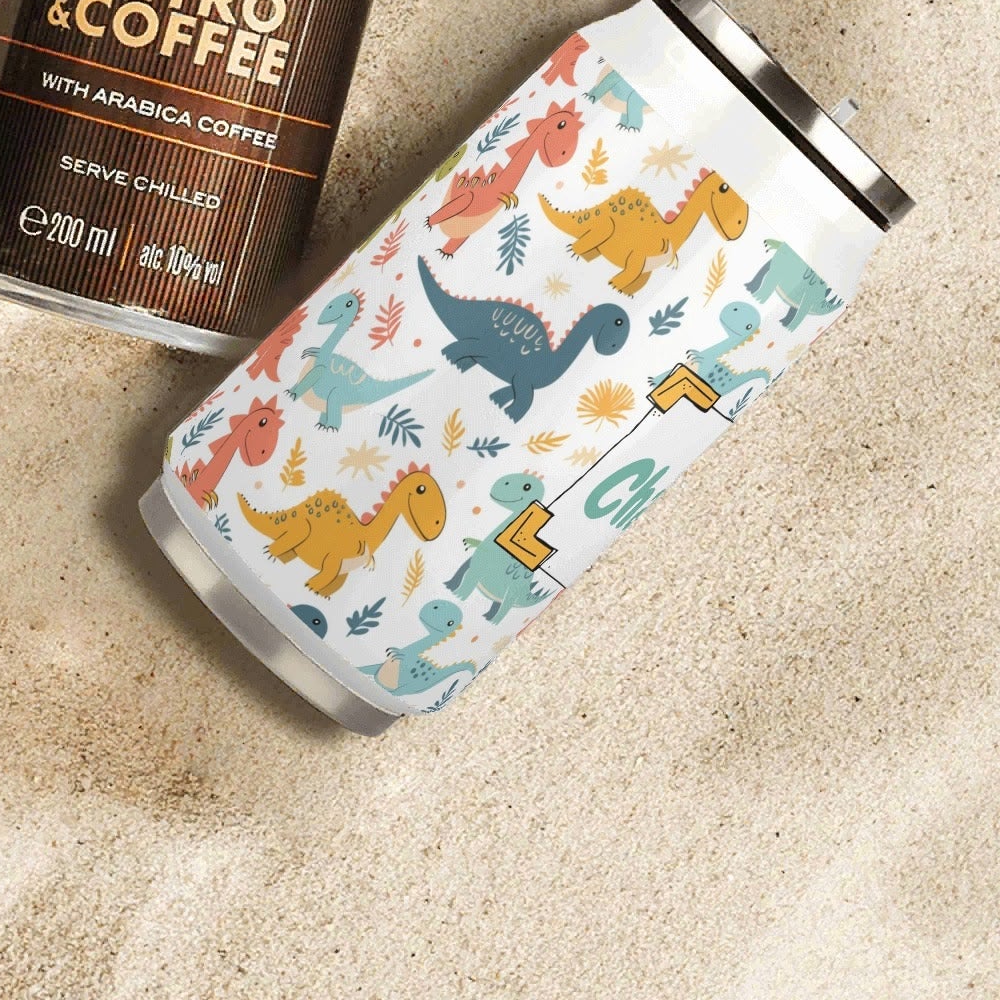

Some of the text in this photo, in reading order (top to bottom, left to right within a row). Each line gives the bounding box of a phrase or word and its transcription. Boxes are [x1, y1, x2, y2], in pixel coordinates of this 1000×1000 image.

[42, 71, 278, 150] WITH ARABICA COFFEE
[59, 155, 221, 210] SERVE CHILLED
[85, 225, 118, 257] ml
[139, 243, 225, 287] alc. 10% vol
